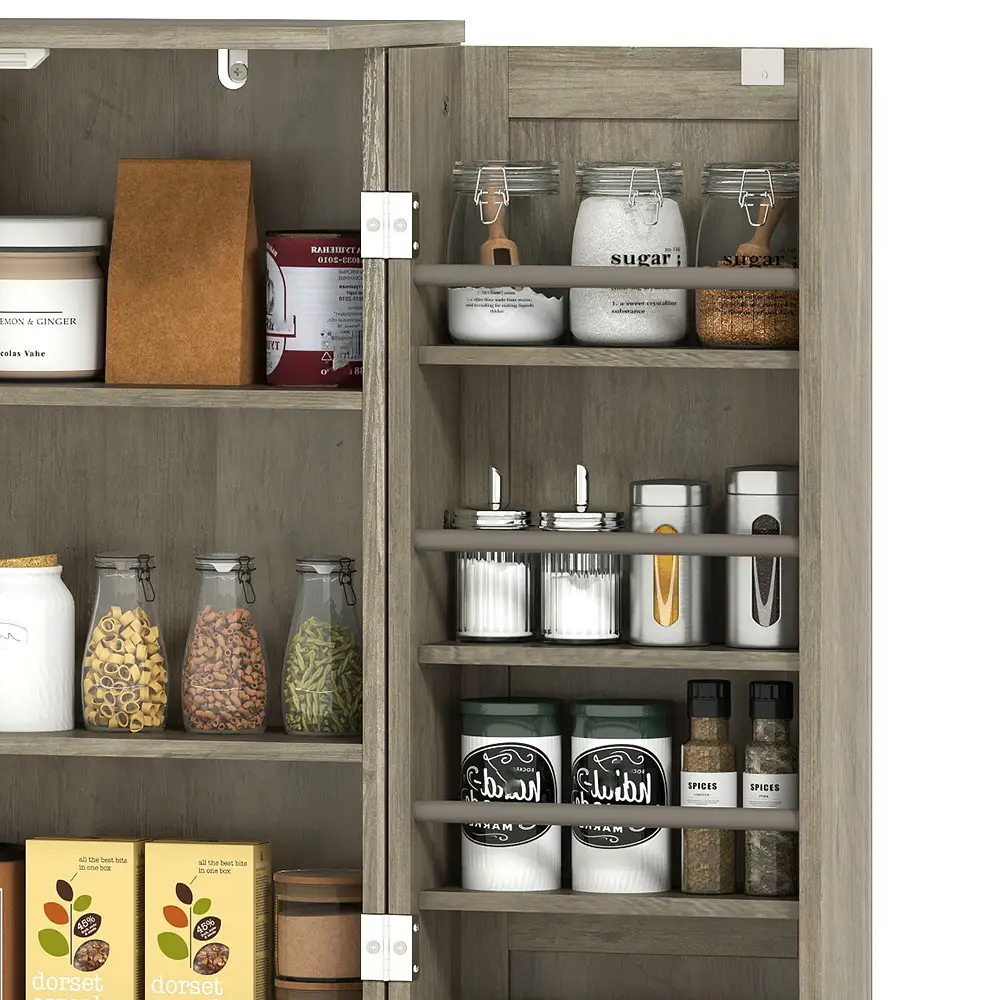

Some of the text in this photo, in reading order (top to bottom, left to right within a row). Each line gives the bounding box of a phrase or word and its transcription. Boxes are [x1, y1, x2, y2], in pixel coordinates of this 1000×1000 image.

[610, 253, 671, 268] sugar
[724, 255, 784, 268] sugar
[28, 316, 34, 326] &
[36, 316, 77, 326] GINGER
[24, 349, 46, 358] Vahe
[688, 782, 718, 790] SPICES
[750, 784, 780, 792] SPICES
[76, 915, 96, 931] 45%
[196, 918, 215, 934] 45%
[32, 972, 103, 992] dorset
[152, 975, 224, 995] dorset
